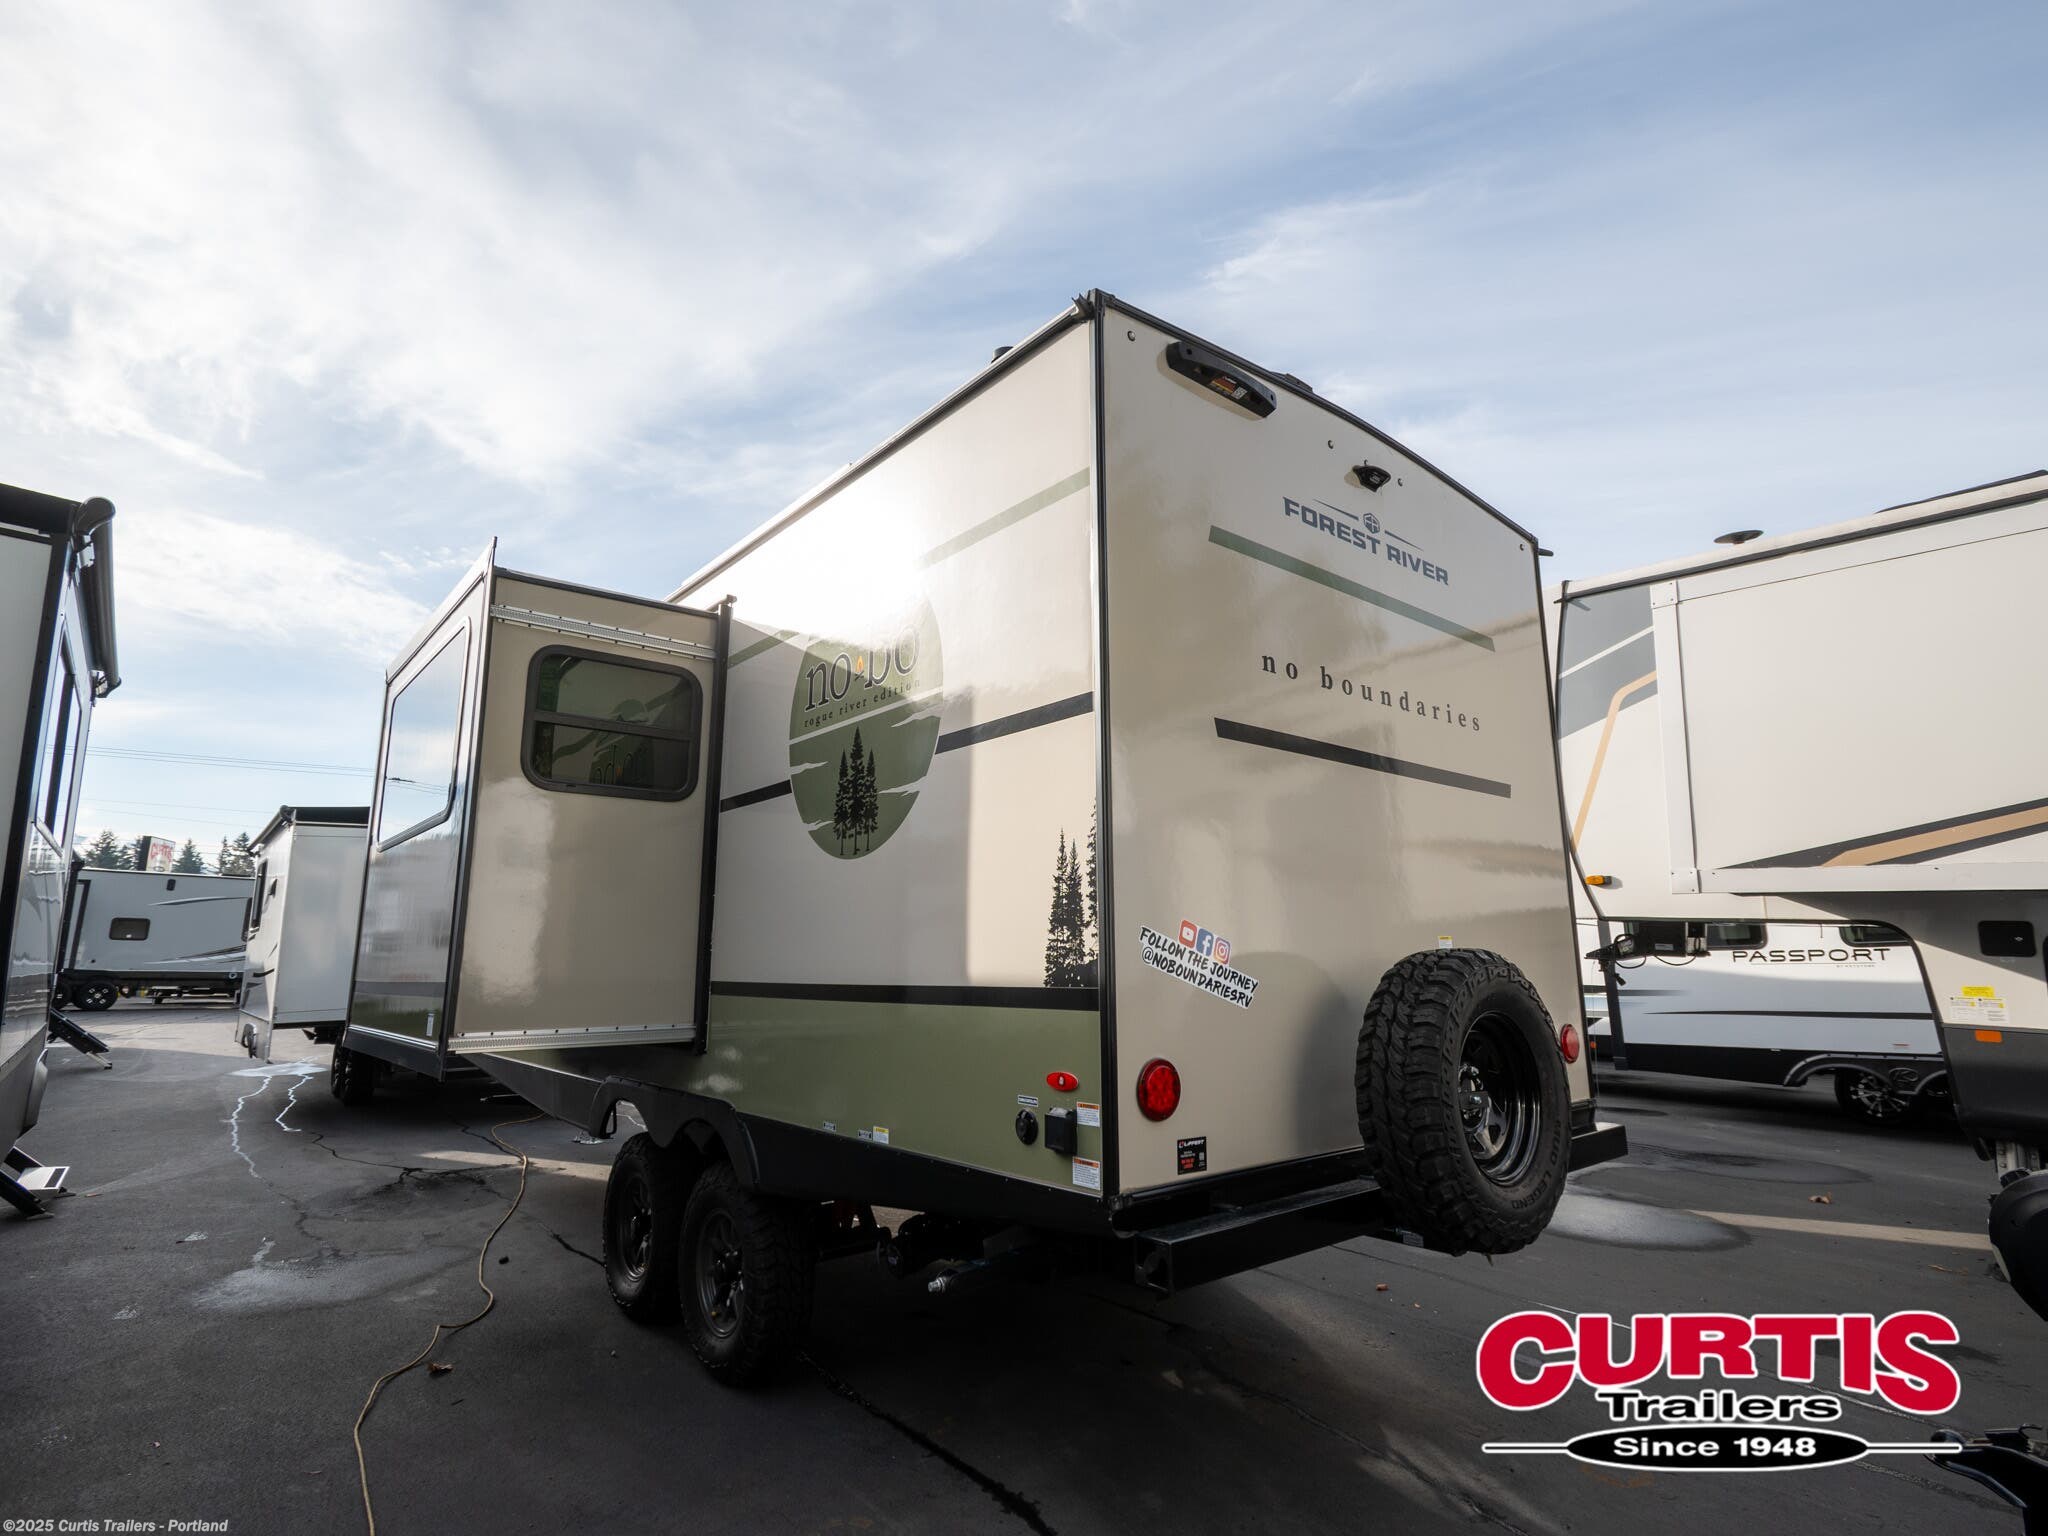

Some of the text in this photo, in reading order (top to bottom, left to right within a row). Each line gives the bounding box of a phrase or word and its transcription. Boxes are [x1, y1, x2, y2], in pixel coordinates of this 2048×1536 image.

[1283, 496, 1449, 586] FOREST RIVER
[804, 680, 920, 728] rogue river edition
[1261, 654, 1480, 732] no boundaries
[1140, 926, 1258, 993] FOLLOW THE JOURNEY
[1142, 946, 1252, 1008] @NOBOUNDARIESRV
[1732, 948, 1891, 962] PASSPORT
[1511, 1169, 1552, 1210] LEGEND
